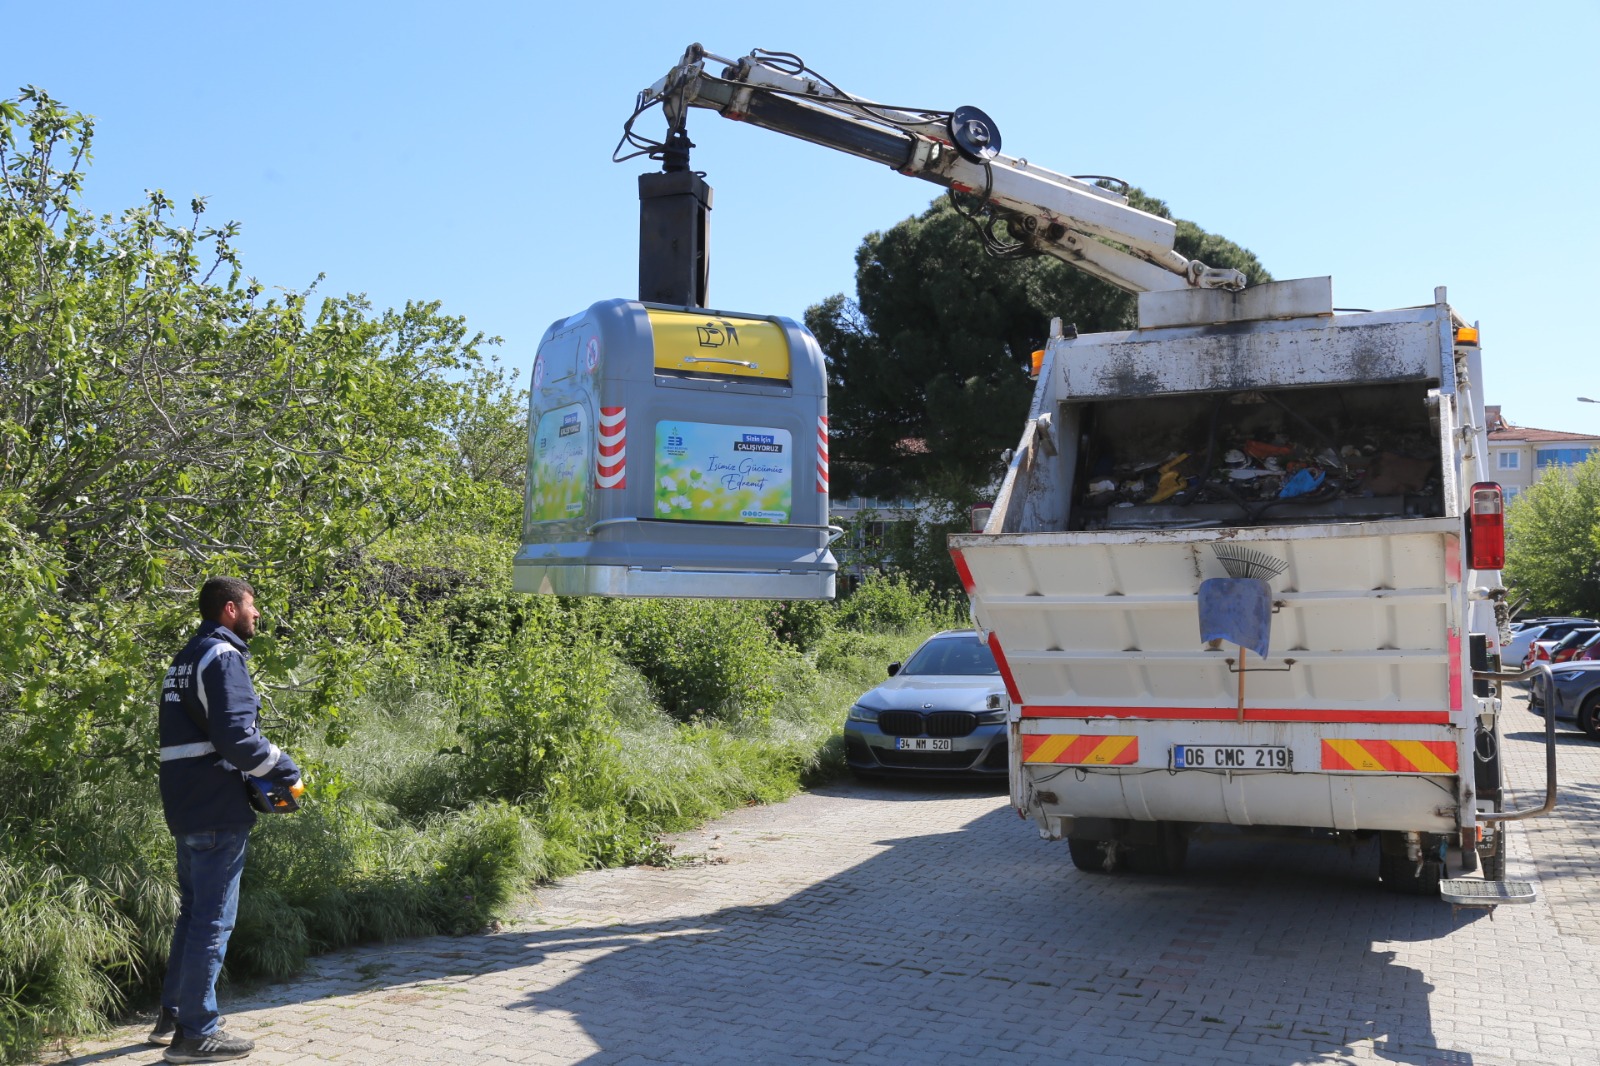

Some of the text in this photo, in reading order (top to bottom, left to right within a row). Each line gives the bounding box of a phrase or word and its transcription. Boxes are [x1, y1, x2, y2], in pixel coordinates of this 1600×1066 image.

[737, 444, 779, 452] ÇALIŞIYORUZ
[738, 457, 783, 476] Gücümüz
[721, 473, 768, 491] Edremit
[900, 739, 949, 750] 34 NM 520
[1185, 748, 1204, 766] 06
[1215, 748, 1245, 767] CMC
[1255, 749, 1286, 767] 219
